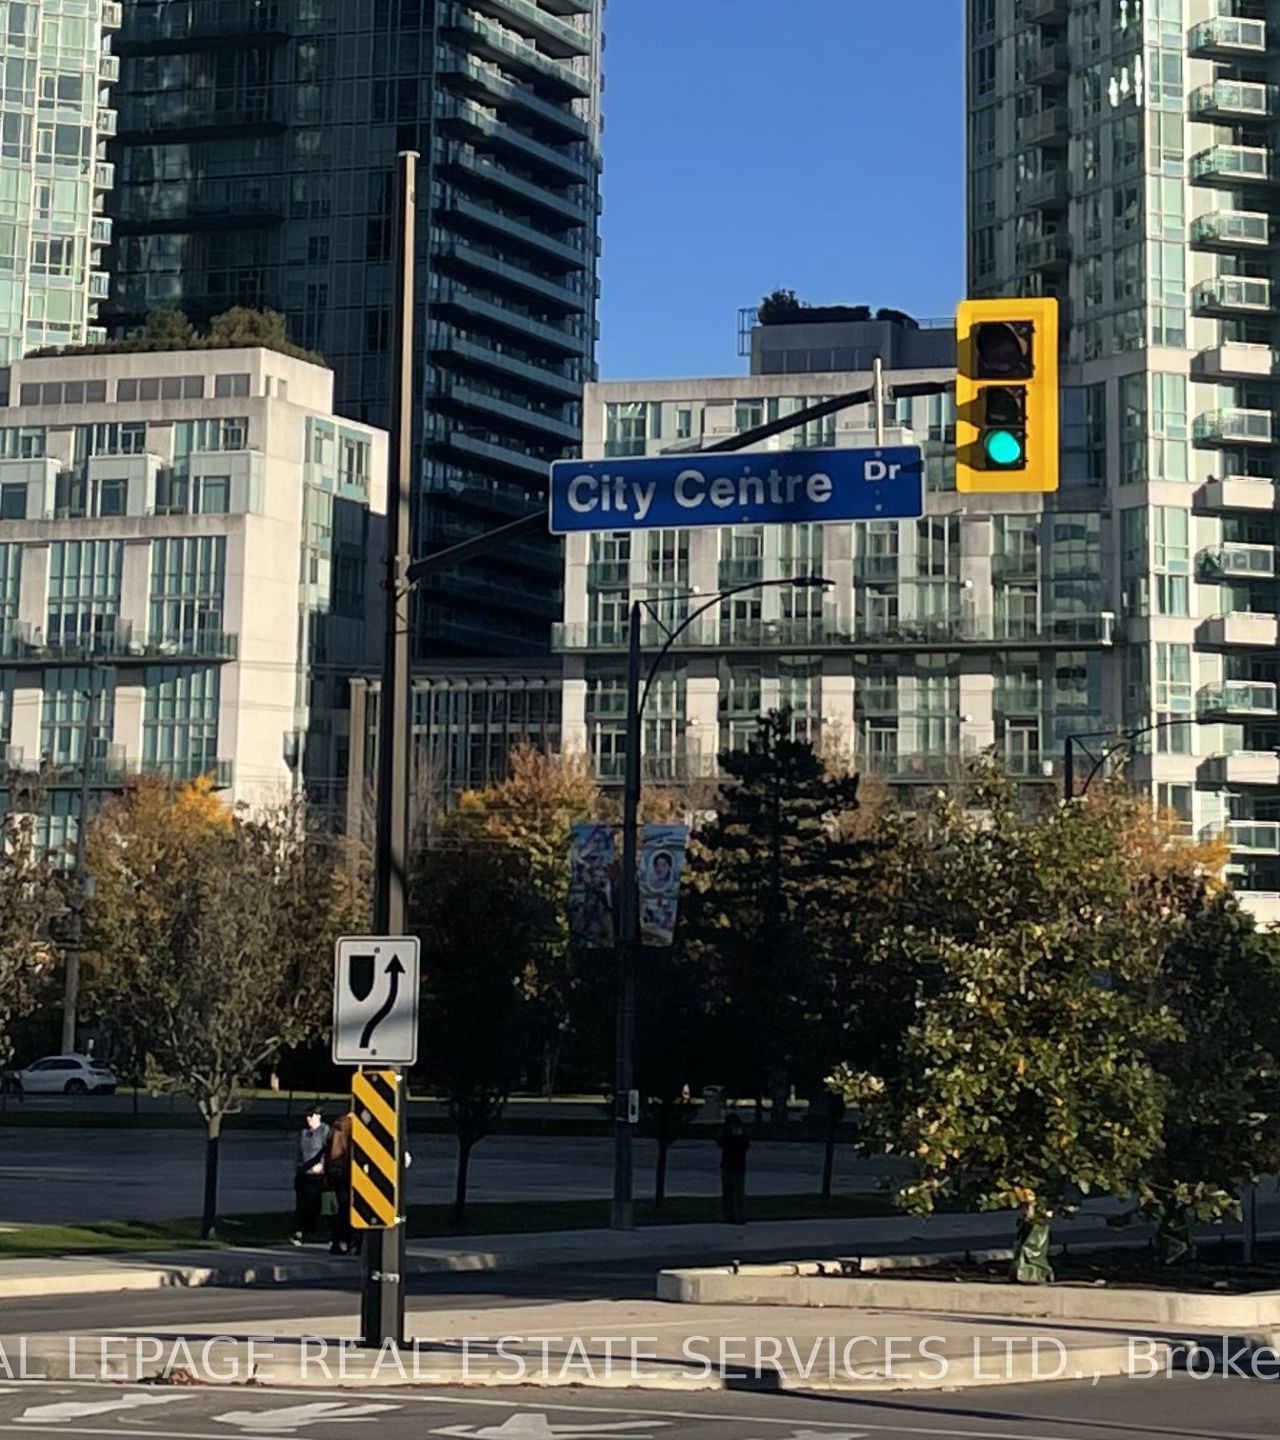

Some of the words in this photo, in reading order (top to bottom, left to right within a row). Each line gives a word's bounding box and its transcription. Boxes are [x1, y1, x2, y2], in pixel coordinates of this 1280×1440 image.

[567, 473, 657, 521] City
[673, 469, 833, 509] Centre
[863, 460, 902, 481] Dr
